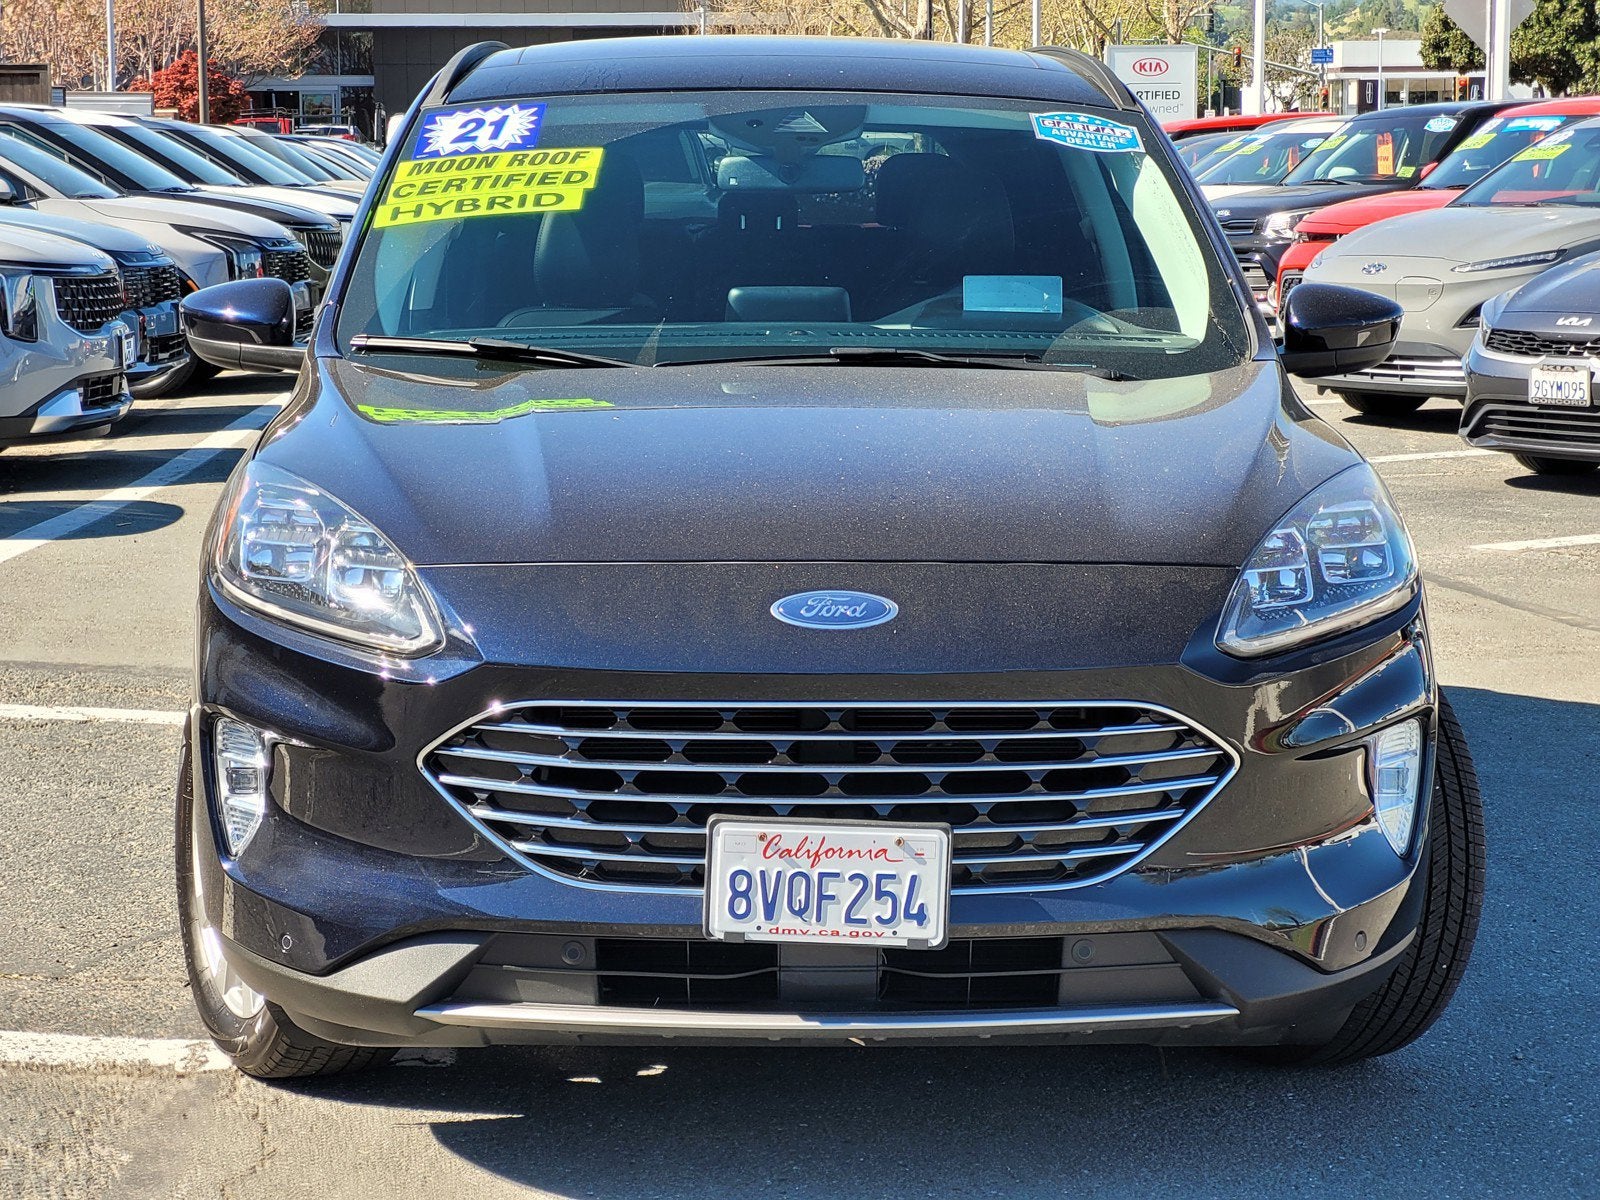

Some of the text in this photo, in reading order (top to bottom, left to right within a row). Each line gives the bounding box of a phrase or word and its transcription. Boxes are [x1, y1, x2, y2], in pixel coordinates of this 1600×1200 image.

[1138, 62, 1164, 73] KIA
[1136, 91, 1181, 100] RTIFIED
[450, 115, 511, 145] 21
[1042, 120, 1132, 138] CARFAX
[1051, 128, 1128, 144] ADVANTAGE
[1066, 136, 1117, 149] DEALER
[406, 150, 591, 177] MOON ROOF
[392, 170, 590, 199] CERTIFIED
[389, 192, 565, 221] HYBRID
[1542, 365, 1577, 373] KIA
[1533, 379, 1586, 400] 9GYM095
[1532, 397, 1587, 406] CONCORD
[800, 596, 869, 617] Ford
[762, 833, 904, 869] California
[728, 868, 928, 927] 8VQF254
[768, 926, 886, 939] dmv.ca.gov
